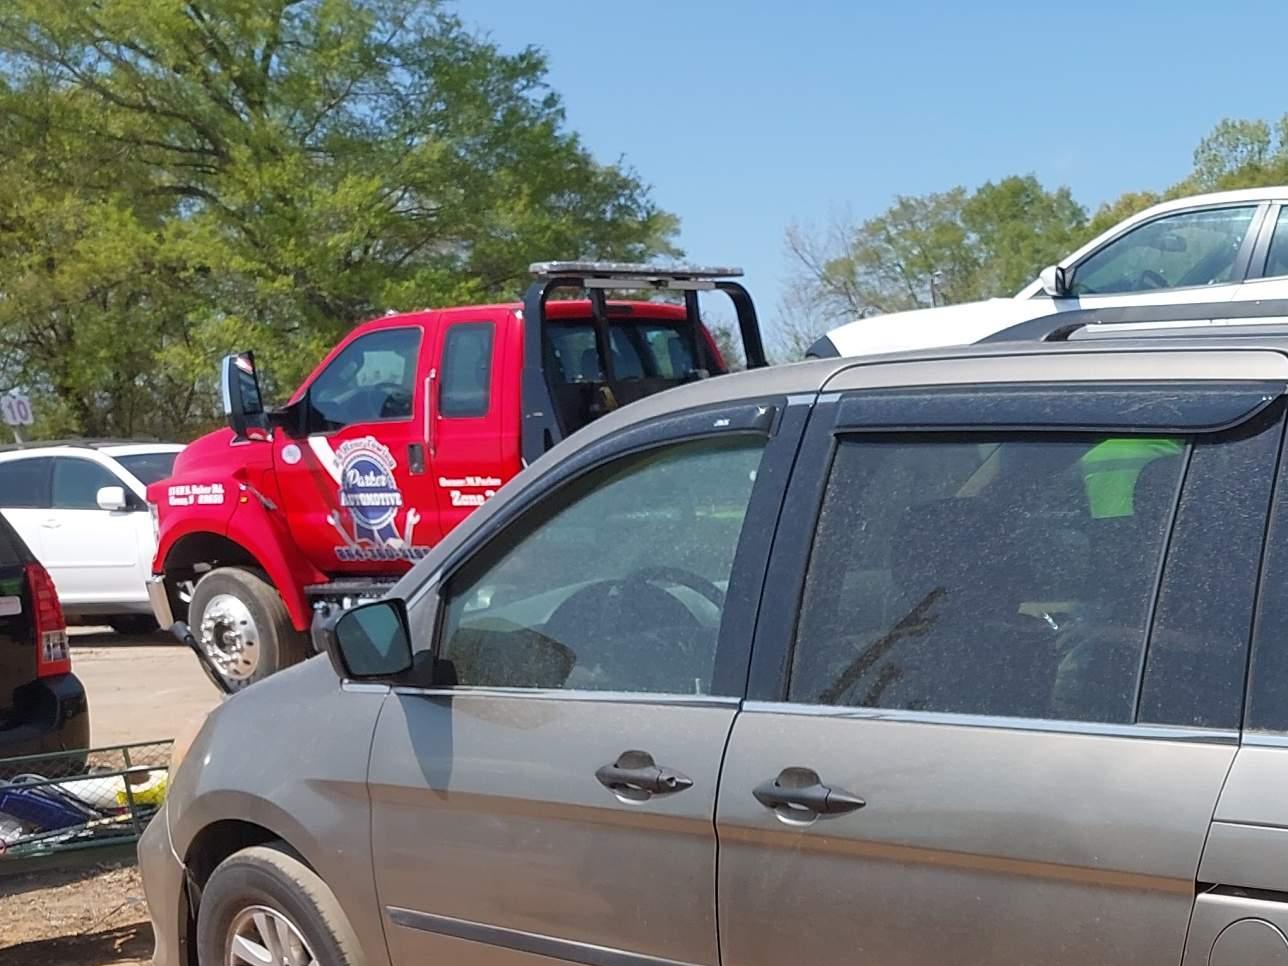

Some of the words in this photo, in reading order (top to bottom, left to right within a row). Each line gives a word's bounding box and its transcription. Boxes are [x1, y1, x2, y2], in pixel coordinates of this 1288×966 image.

[8, 399, 29, 421] 10
[345, 467, 387, 489] Parker
[340, 490, 403, 508] AUTOMOTIVE
